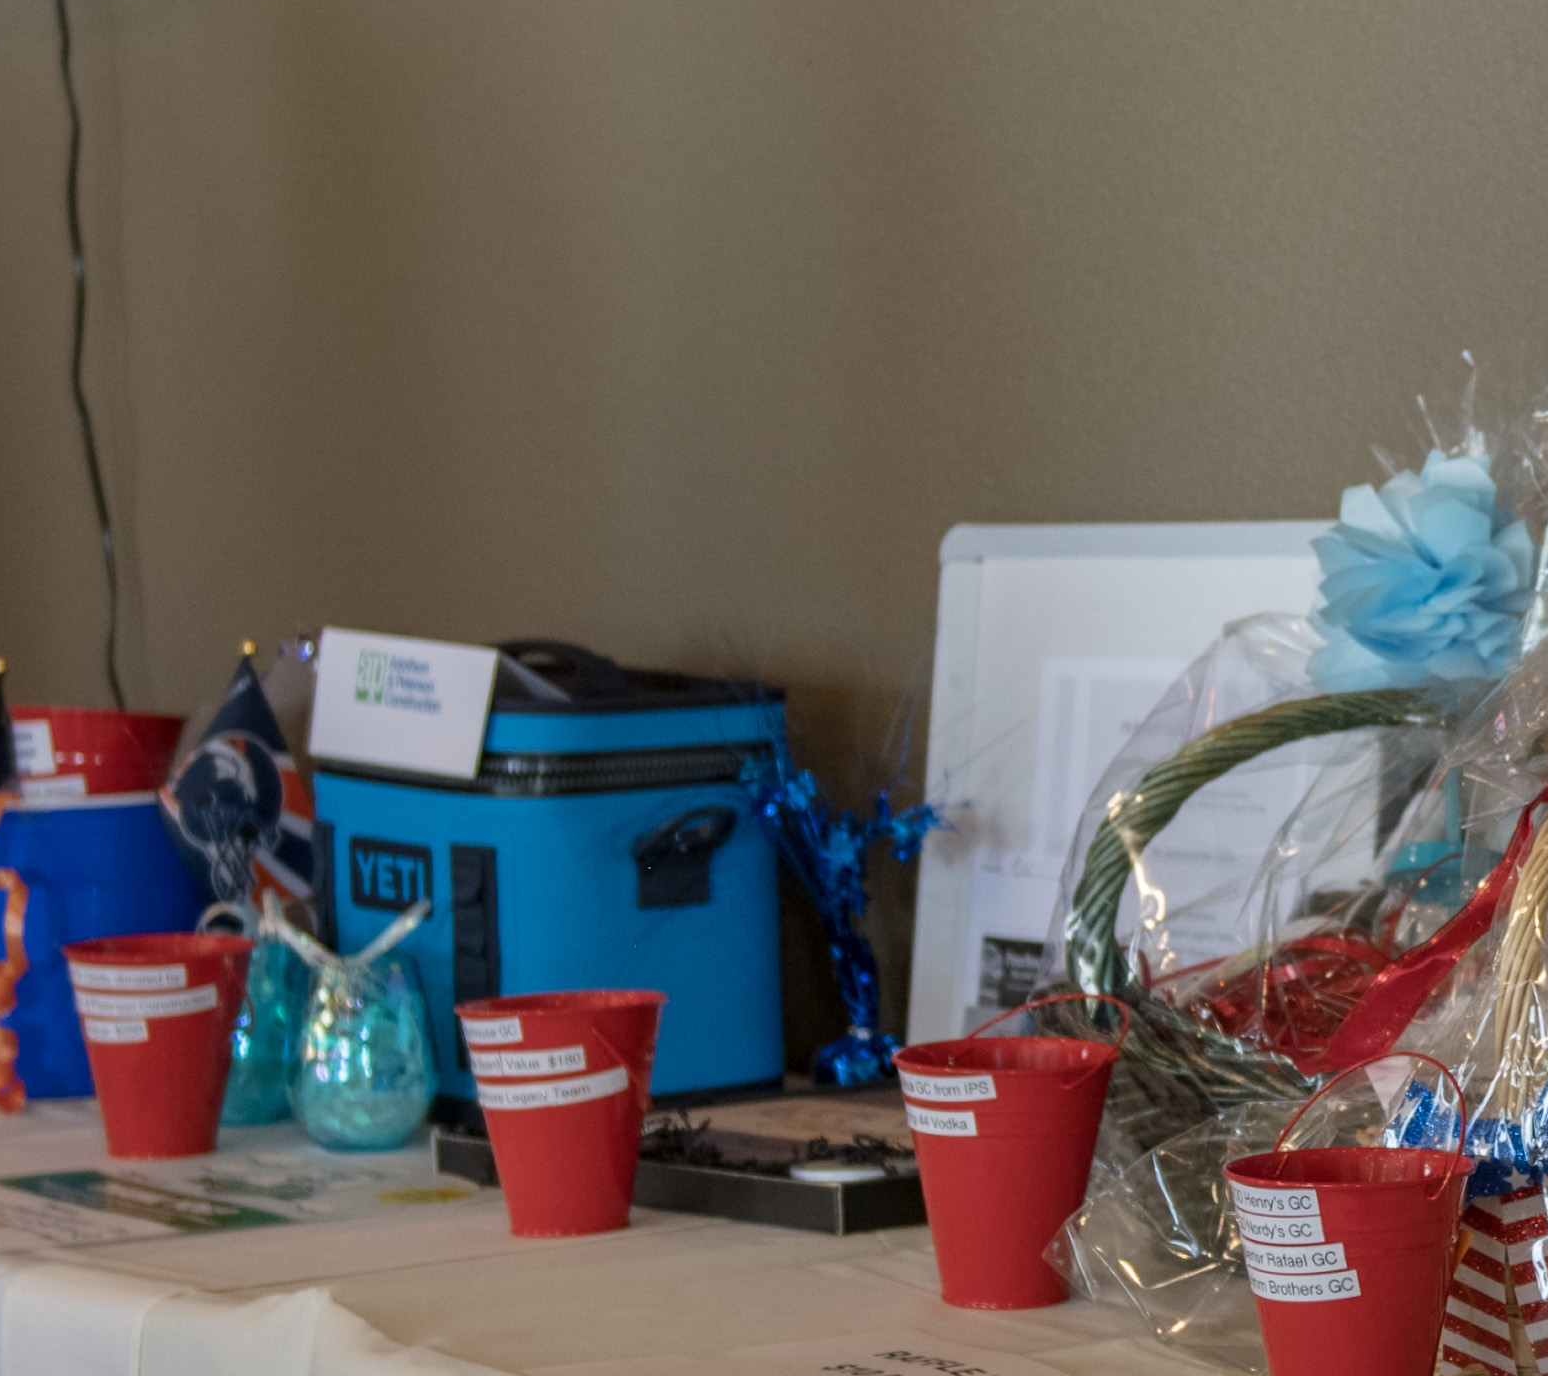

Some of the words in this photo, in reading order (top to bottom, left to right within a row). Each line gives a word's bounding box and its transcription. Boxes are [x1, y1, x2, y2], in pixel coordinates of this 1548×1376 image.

[355, 851, 424, 901] YETI
[505, 1057, 540, 1070] Value
[505, 1090, 548, 1105] Legacy
[553, 1085, 591, 1099] Team
[933, 1084, 961, 1097] from
[964, 1081, 990, 1095] IPS
[931, 1116, 968, 1130] Vodka
[1245, 1193, 1285, 1212] Henry's
[1288, 1195, 1312, 1210] GC
[1246, 1219, 1286, 1239] Nordy's
[1288, 1223, 1313, 1238] GC
[1267, 1252, 1308, 1268] Rafael
[1312, 1251, 1338, 1266] GC
[1268, 1279, 1324, 1296] Brothers
[1328, 1277, 1355, 1293] GC
[873, 1350, 989, 1376] RAFFLE
